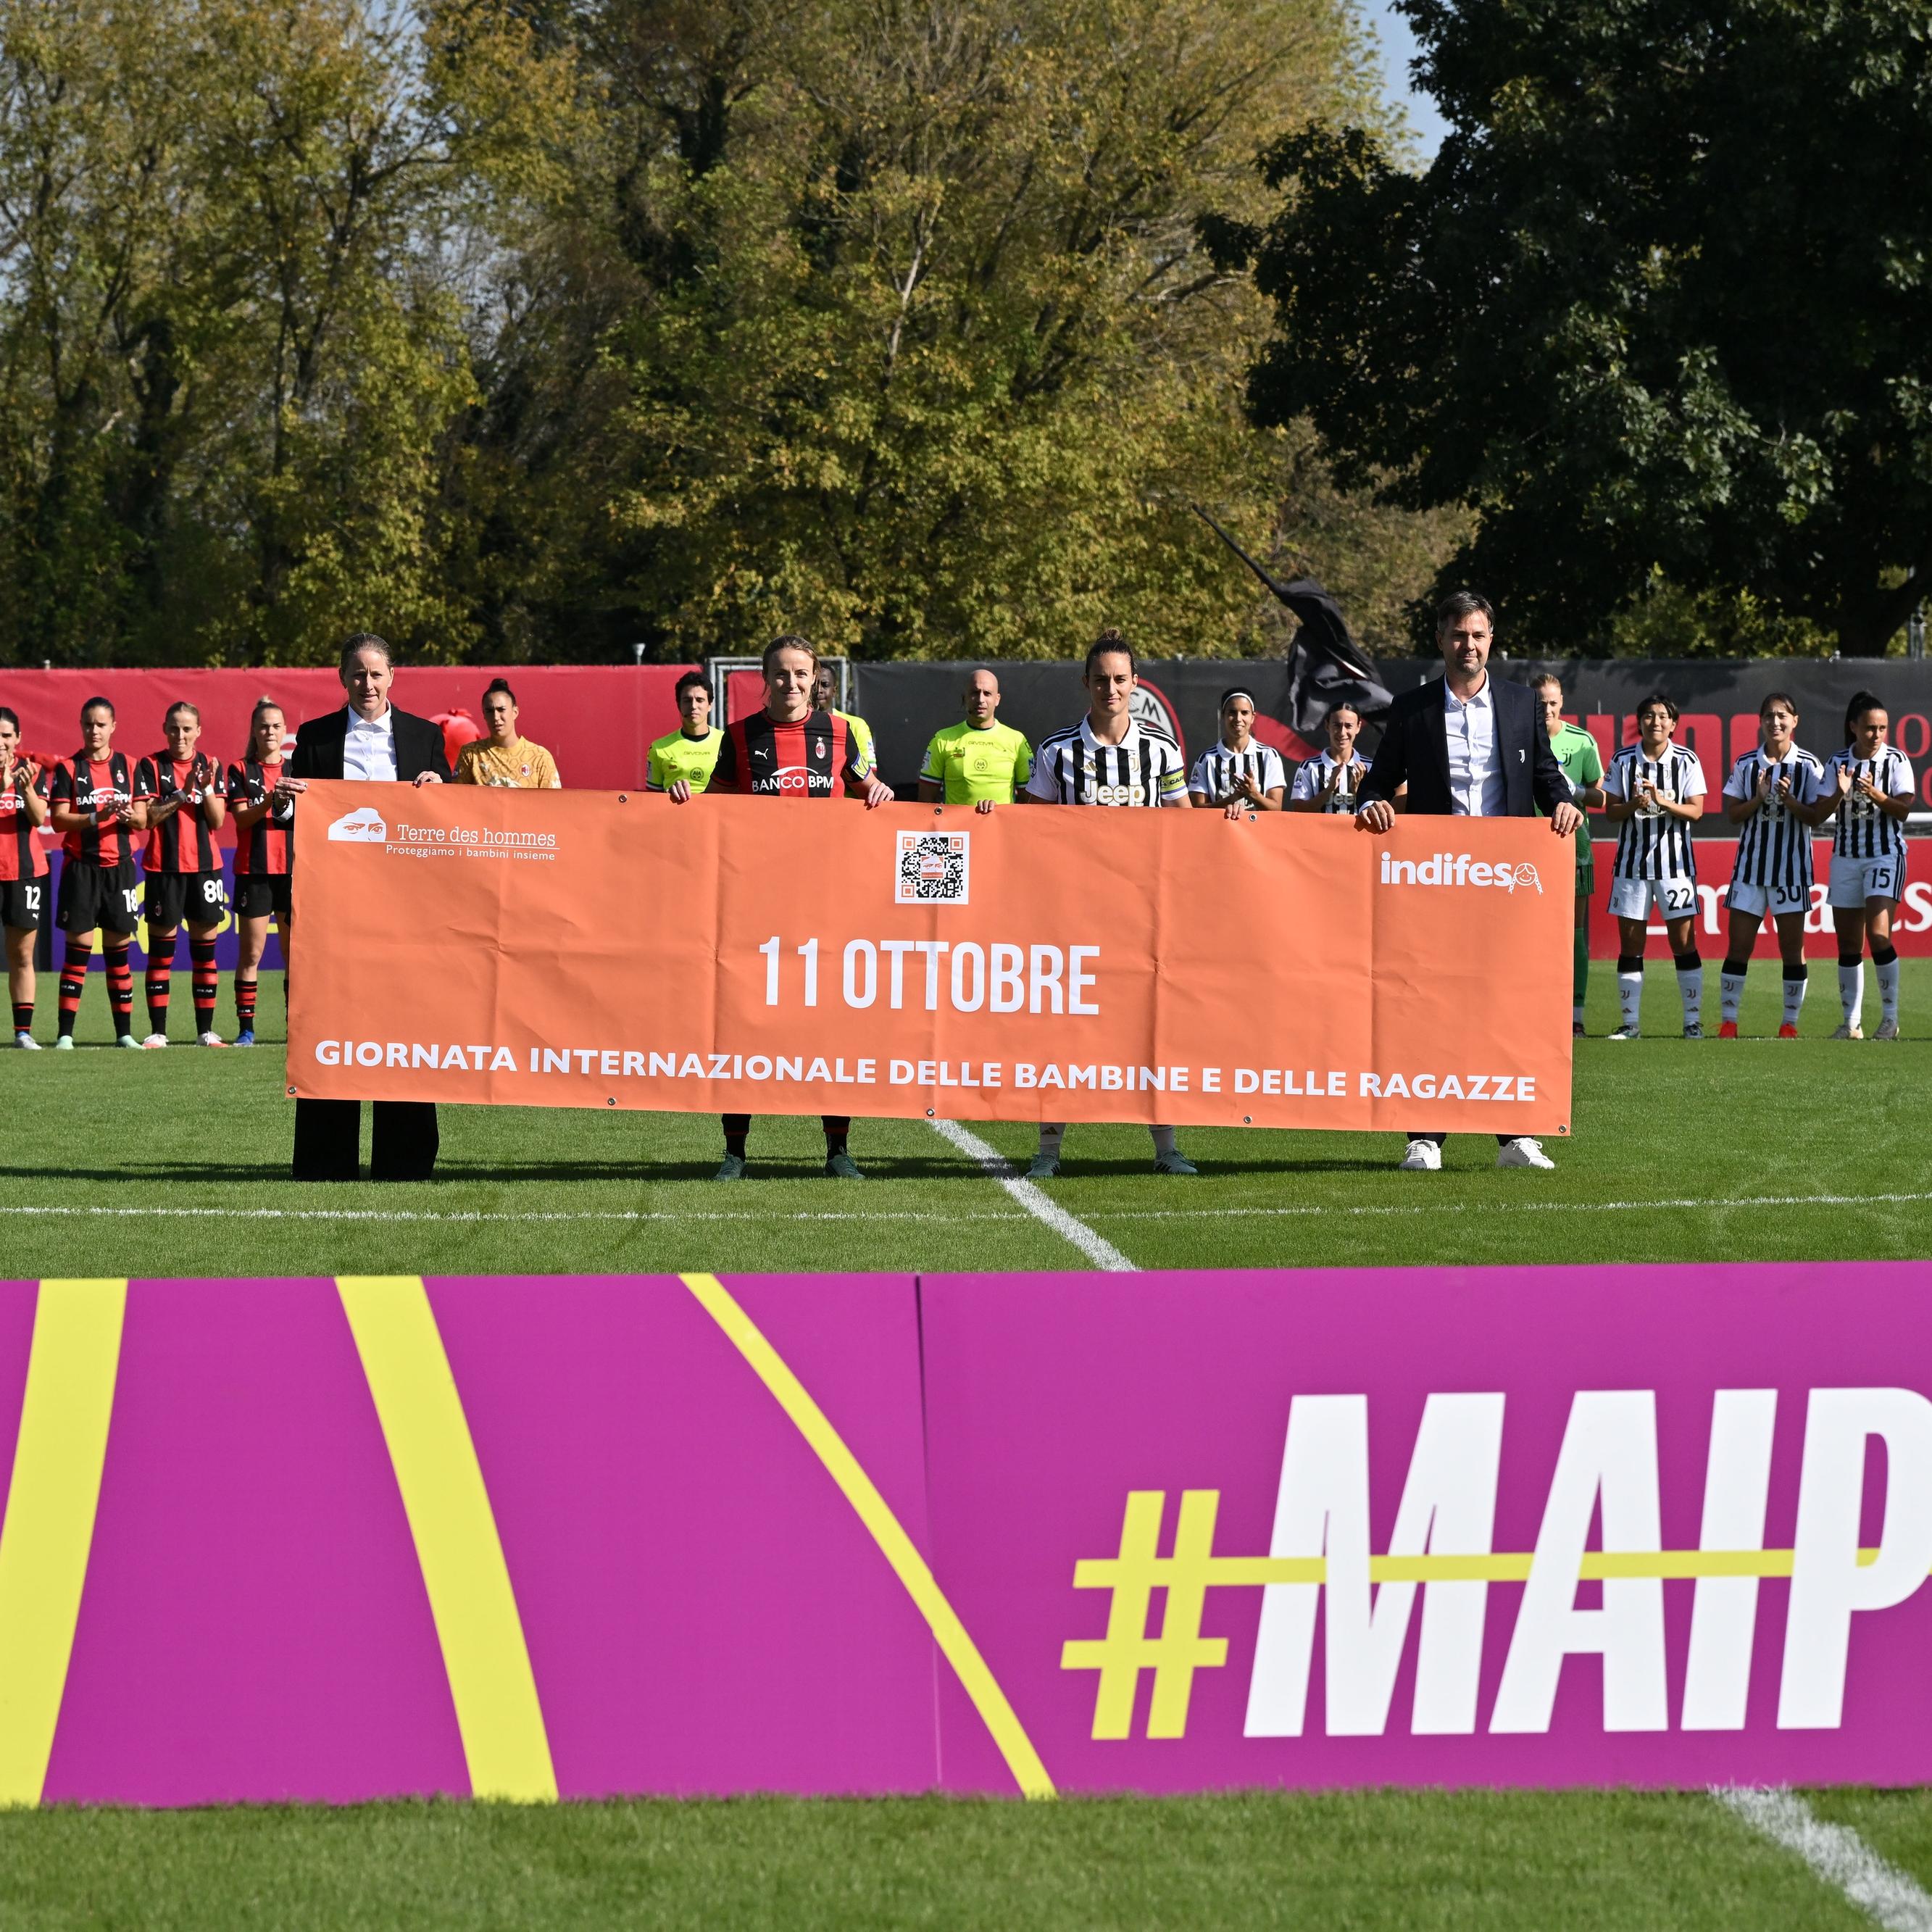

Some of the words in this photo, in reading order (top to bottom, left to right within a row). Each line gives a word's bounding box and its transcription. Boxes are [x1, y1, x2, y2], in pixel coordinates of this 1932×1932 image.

[752, 776, 804, 793] BANCO
[808, 775, 834, 789] BPM
[1080, 780, 1146, 806] Jeep
[397, 825, 445, 842] Terre
[450, 826, 478, 844] des
[483, 828, 556, 846] hommes
[386, 845, 455, 857] Proteggiamo
[459, 847, 462, 856] i
[466, 849, 509, 859] bambini
[513, 850, 555, 860] insieme
[1872, 868, 1891, 888] 15
[25, 886, 41, 909] 12
[122, 889, 138, 912] 18
[203, 880, 223, 903] 80
[1667, 888, 1694, 910] 22
[843, 939, 1100, 1015] OTTOBRE
[315, 1040, 517, 1072] GIORNATA
[530, 1048, 876, 1083] INTERNAZIONALE
[890, 1060, 1002, 1087] DELLE
[1015, 1064, 1189, 1091] BAMBINE
[1203, 1068, 1221, 1092] E
[1235, 1069, 1346, 1096] DELLE
[1360, 1073, 1536, 1101] RAGAZZE
